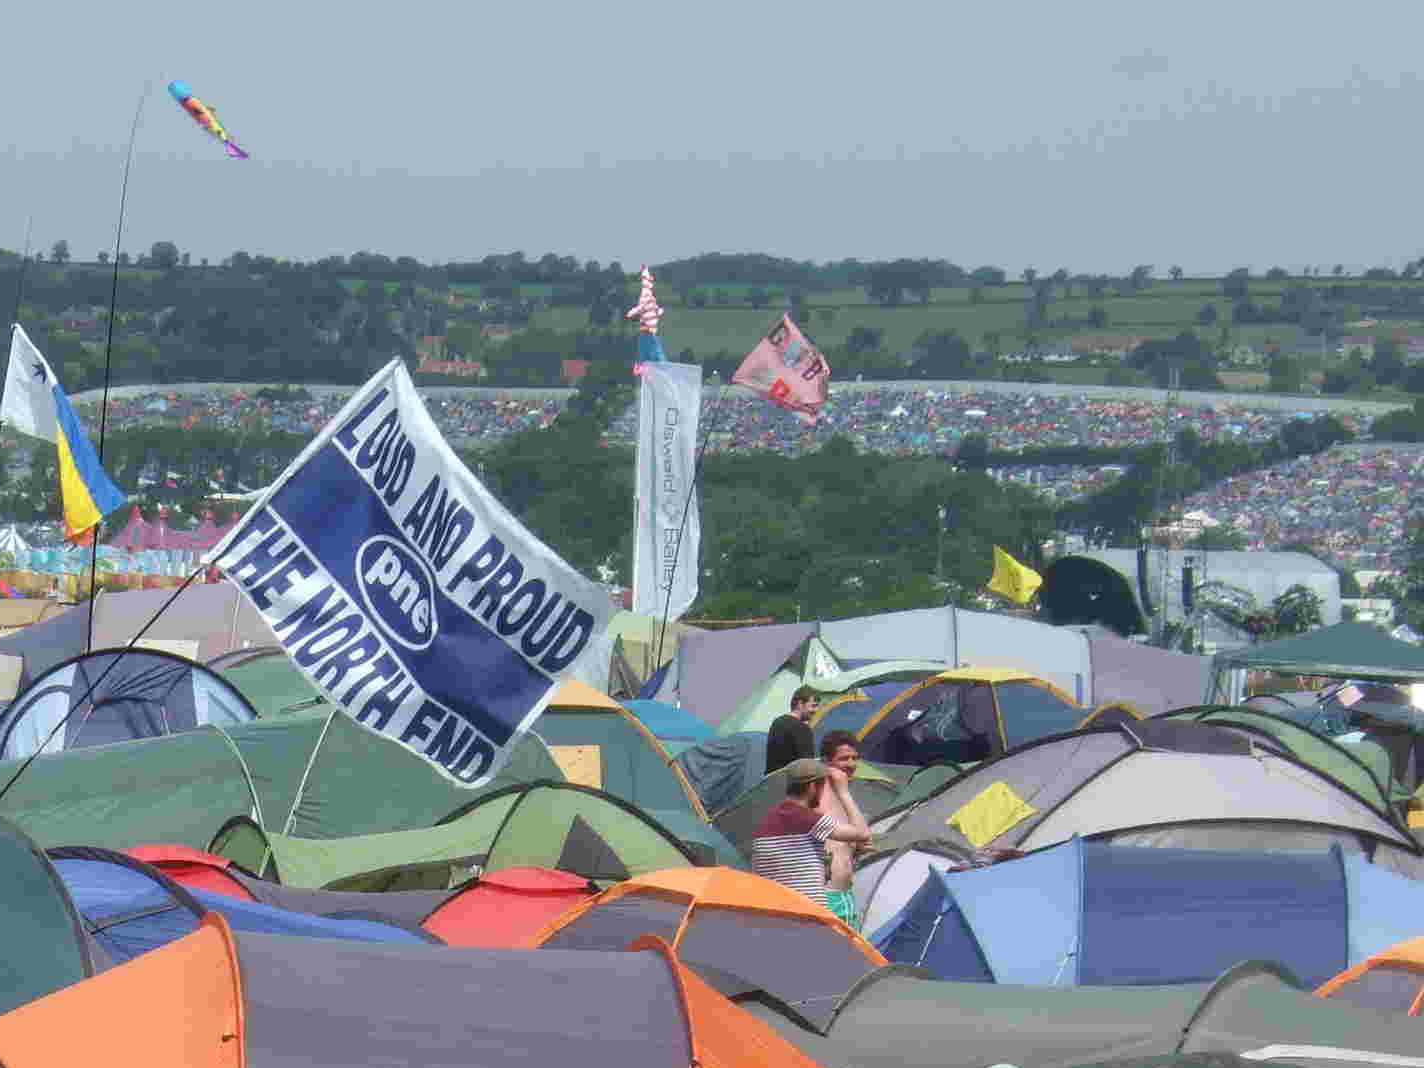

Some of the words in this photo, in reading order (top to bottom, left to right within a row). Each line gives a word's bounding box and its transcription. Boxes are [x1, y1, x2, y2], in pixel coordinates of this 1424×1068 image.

[227, 510, 318, 610] THE
[273, 585, 415, 731] NORTH
[400, 700, 495, 783] END
[336, 388, 417, 507] LOUD
[402, 475, 475, 572] AND
[446, 534, 594, 673] PROUD
[364, 547, 430, 633] pne
